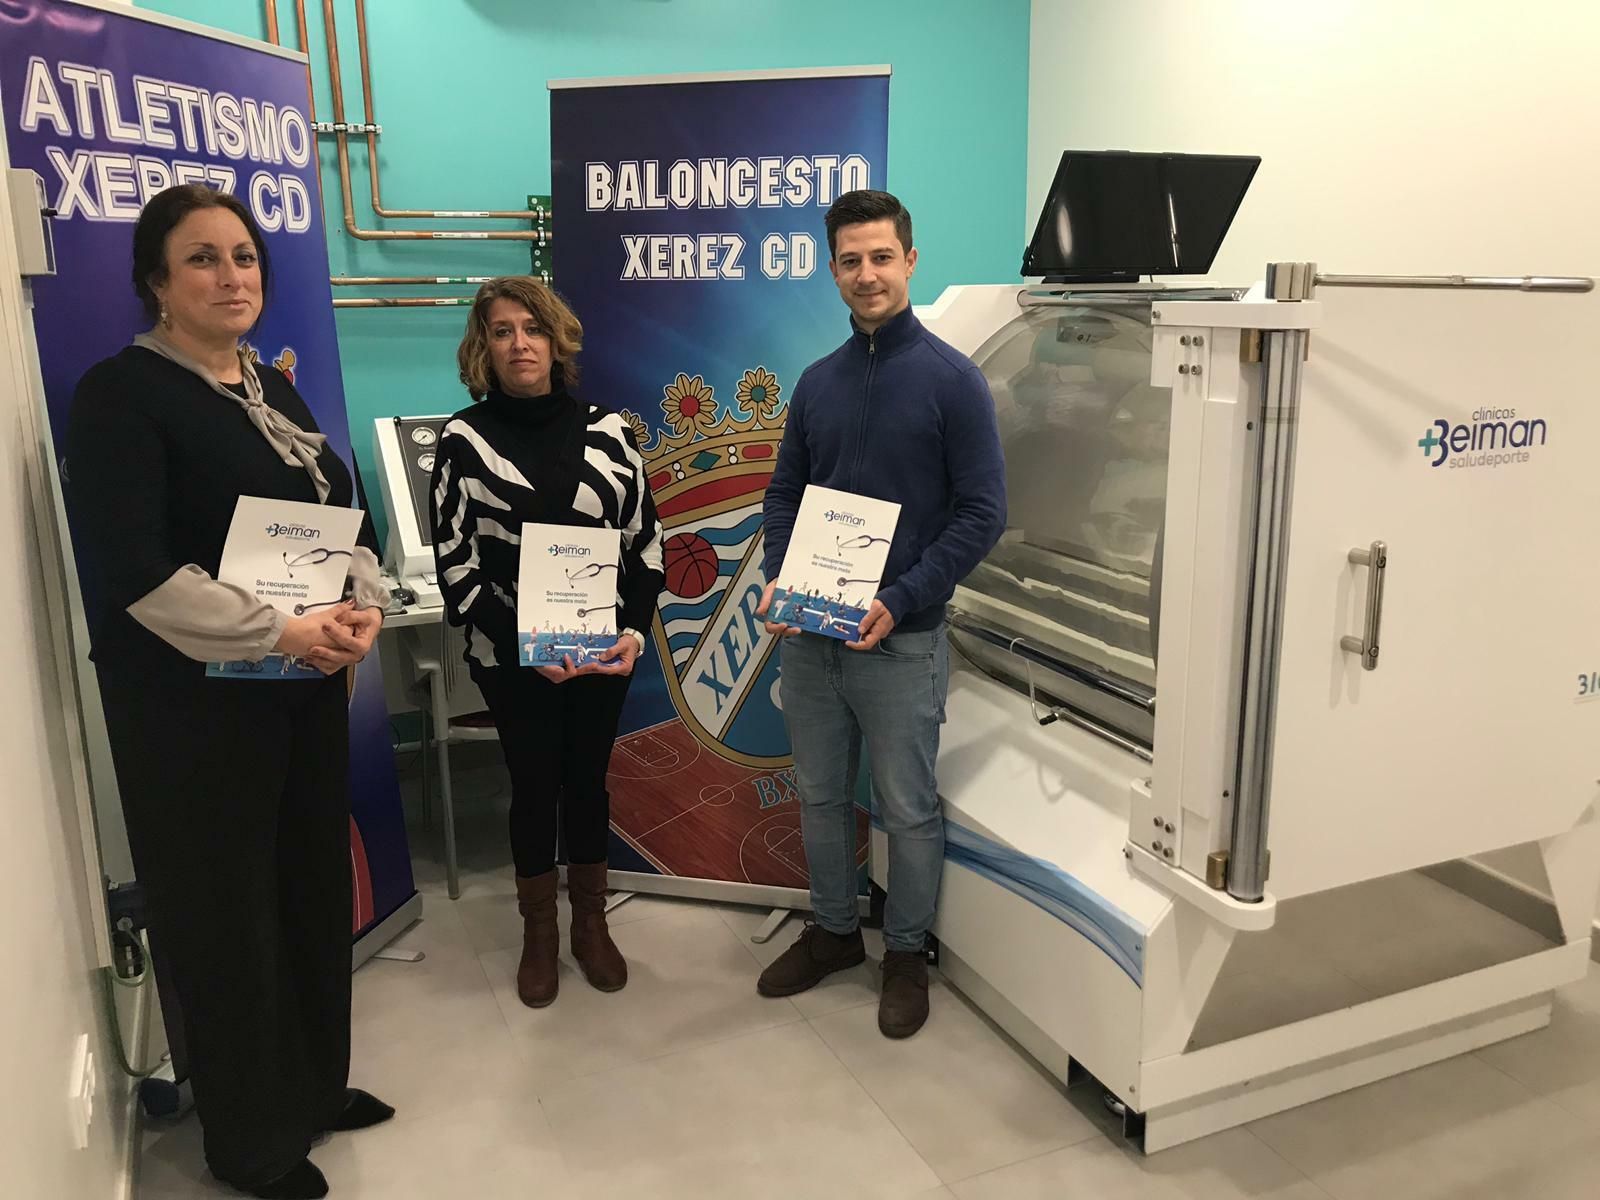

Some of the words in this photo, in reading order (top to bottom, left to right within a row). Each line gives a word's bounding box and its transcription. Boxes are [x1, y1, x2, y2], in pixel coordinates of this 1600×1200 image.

[20, 56, 310, 168] ATLETISMO
[250, 170, 311, 233] CD
[585, 154, 870, 211] BALONCESTO
[620, 232, 746, 280] XEREZ
[760, 232, 817, 280] CD
[1432, 419, 1546, 467] Beiman
[1449, 450, 1530, 469] saludeporte
